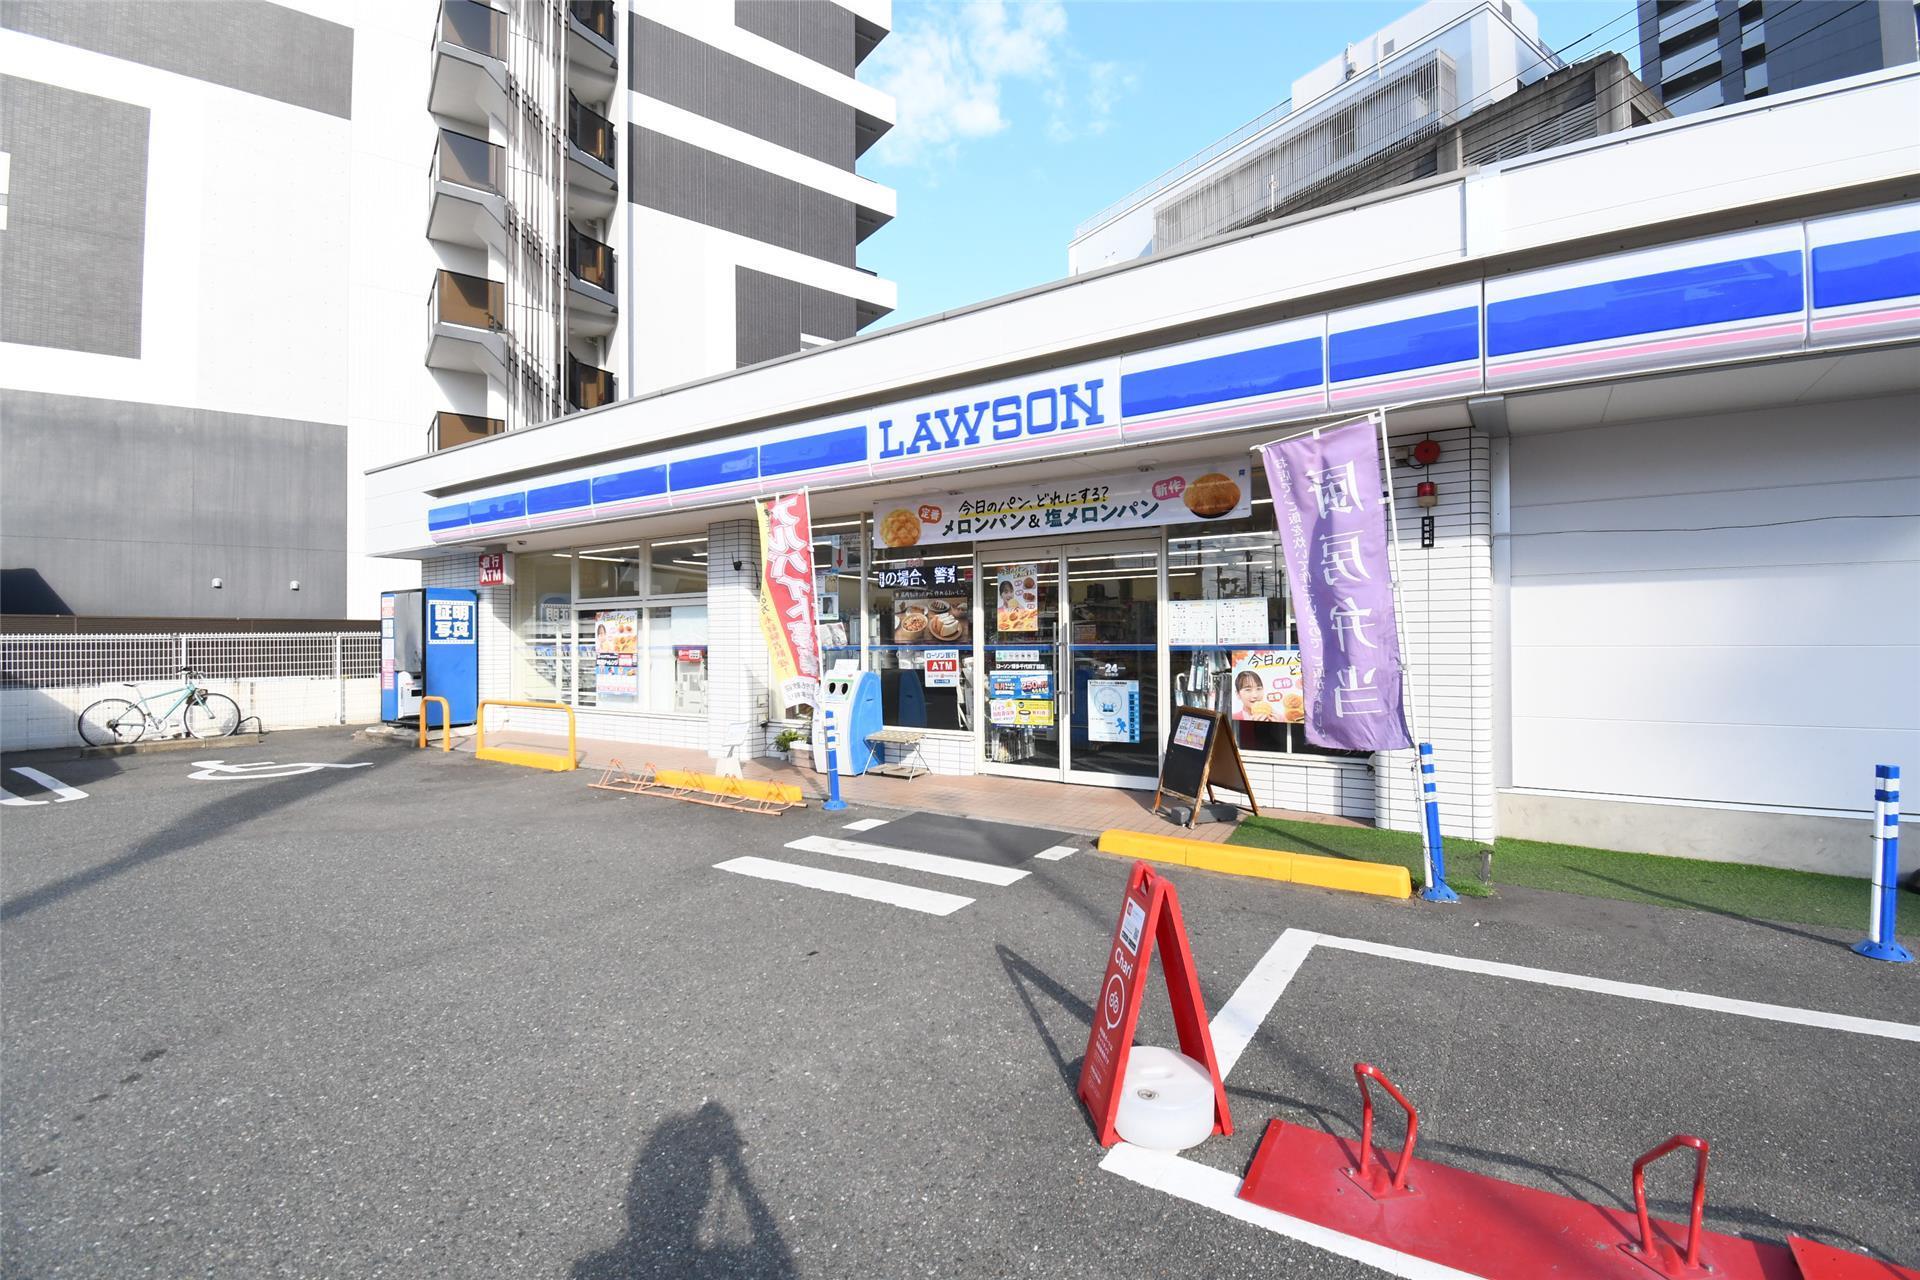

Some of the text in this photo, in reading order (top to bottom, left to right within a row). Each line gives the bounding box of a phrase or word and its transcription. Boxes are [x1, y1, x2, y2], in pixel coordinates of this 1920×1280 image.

[879, 379, 1104, 459] LAWSON
[1154, 479, 1184, 497] 新作
[959, 486, 1109, 516] 今日のパン、どれにする?
[920, 506, 939, 522] 定番
[481, 554, 500, 568] 銀行
[481, 569, 501, 582] ATM
[434, 604, 469, 621] 証明
[434, 621, 469, 638] 写真
[926, 651, 957, 659] ローソン銀行
[931, 660, 953, 671] ATM
[1104, 663, 1118, 673] 24
[1114, 947, 1133, 981] Chari
